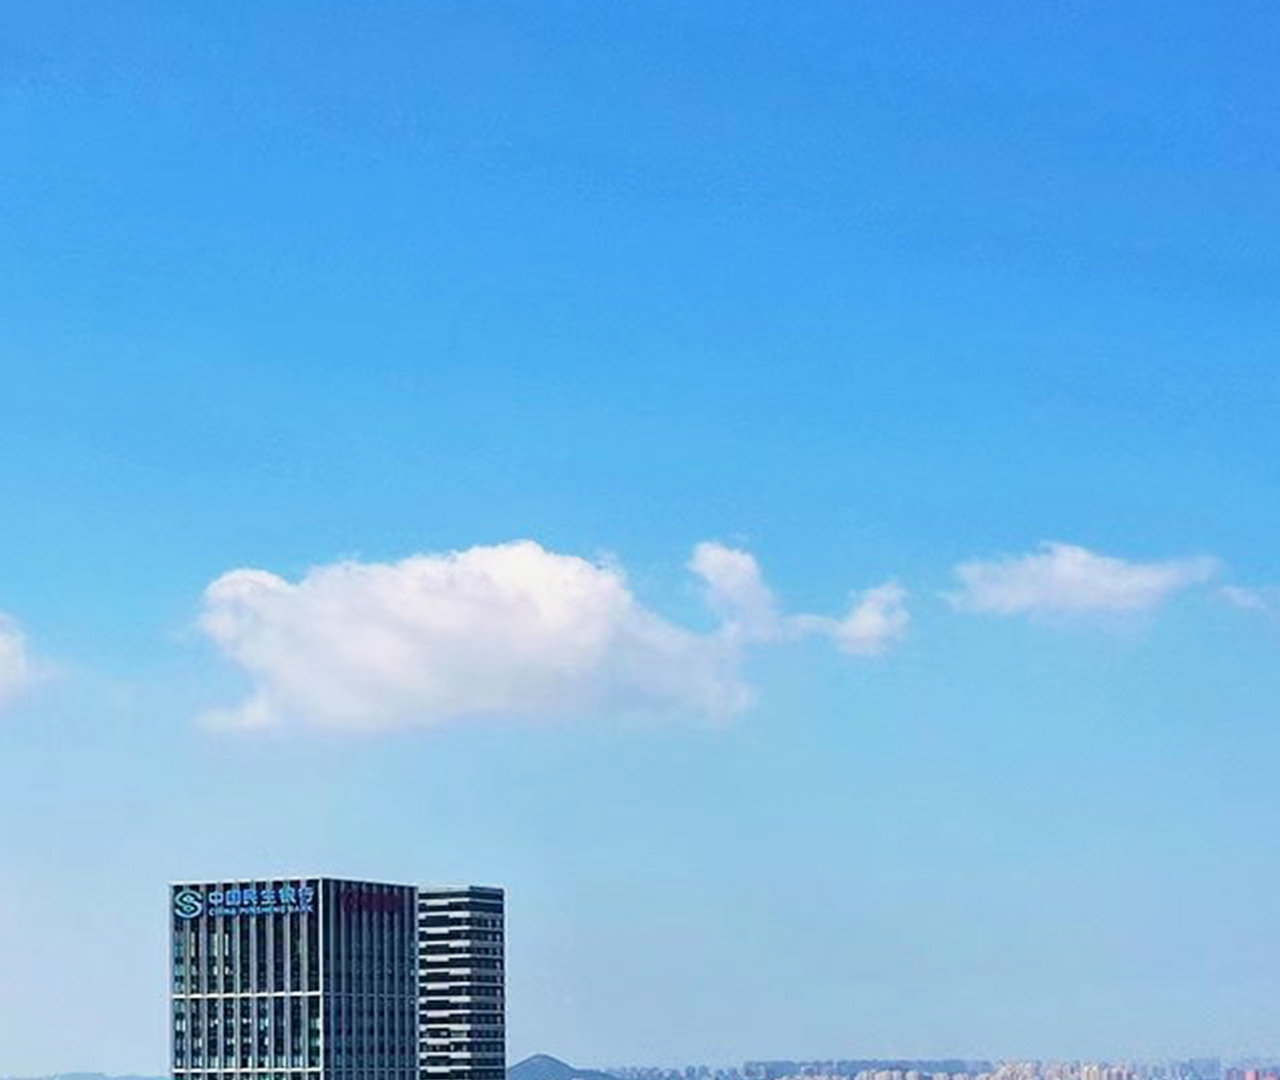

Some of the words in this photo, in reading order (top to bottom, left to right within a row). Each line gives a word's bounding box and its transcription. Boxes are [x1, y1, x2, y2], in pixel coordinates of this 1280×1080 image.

[208, 886, 314, 906] 中国民生银行
